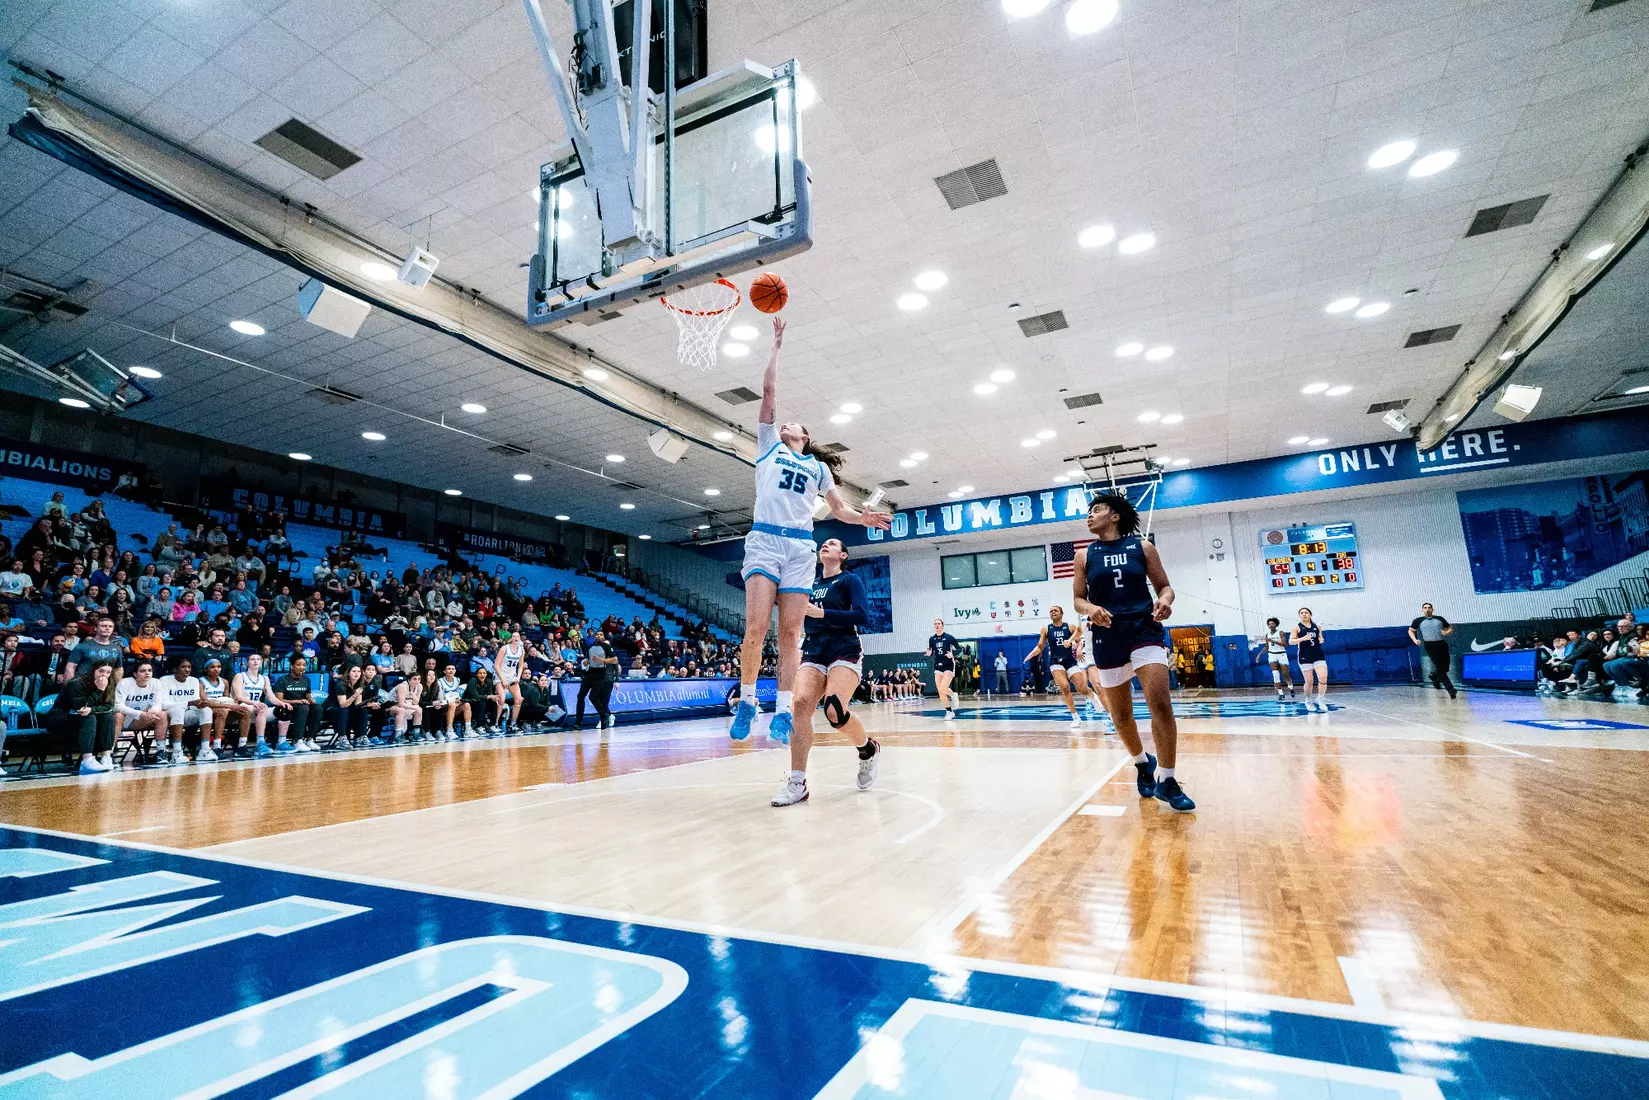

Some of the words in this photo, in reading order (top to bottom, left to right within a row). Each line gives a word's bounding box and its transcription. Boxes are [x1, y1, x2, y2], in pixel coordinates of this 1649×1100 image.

[1318, 444, 1397, 475] ONLY
[778, 468, 808, 494] 35
[232, 488, 383, 532] COLUMBIA
[1298, 542, 1327, 555] 8:13
[1104, 553, 1128, 567] FDU
[1338, 559, 1354, 570] 38
[1274, 564, 1290, 575] 54
[1307, 562, 1315, 570] 4
[1112, 568, 1124, 588] 2
[1302, 577, 1316, 586] 23
[954, 608, 971, 620] Ivy
[125, 693, 155, 702] LIONS
[169, 688, 195, 697] LIONS
[249, 691, 261, 701] 12
